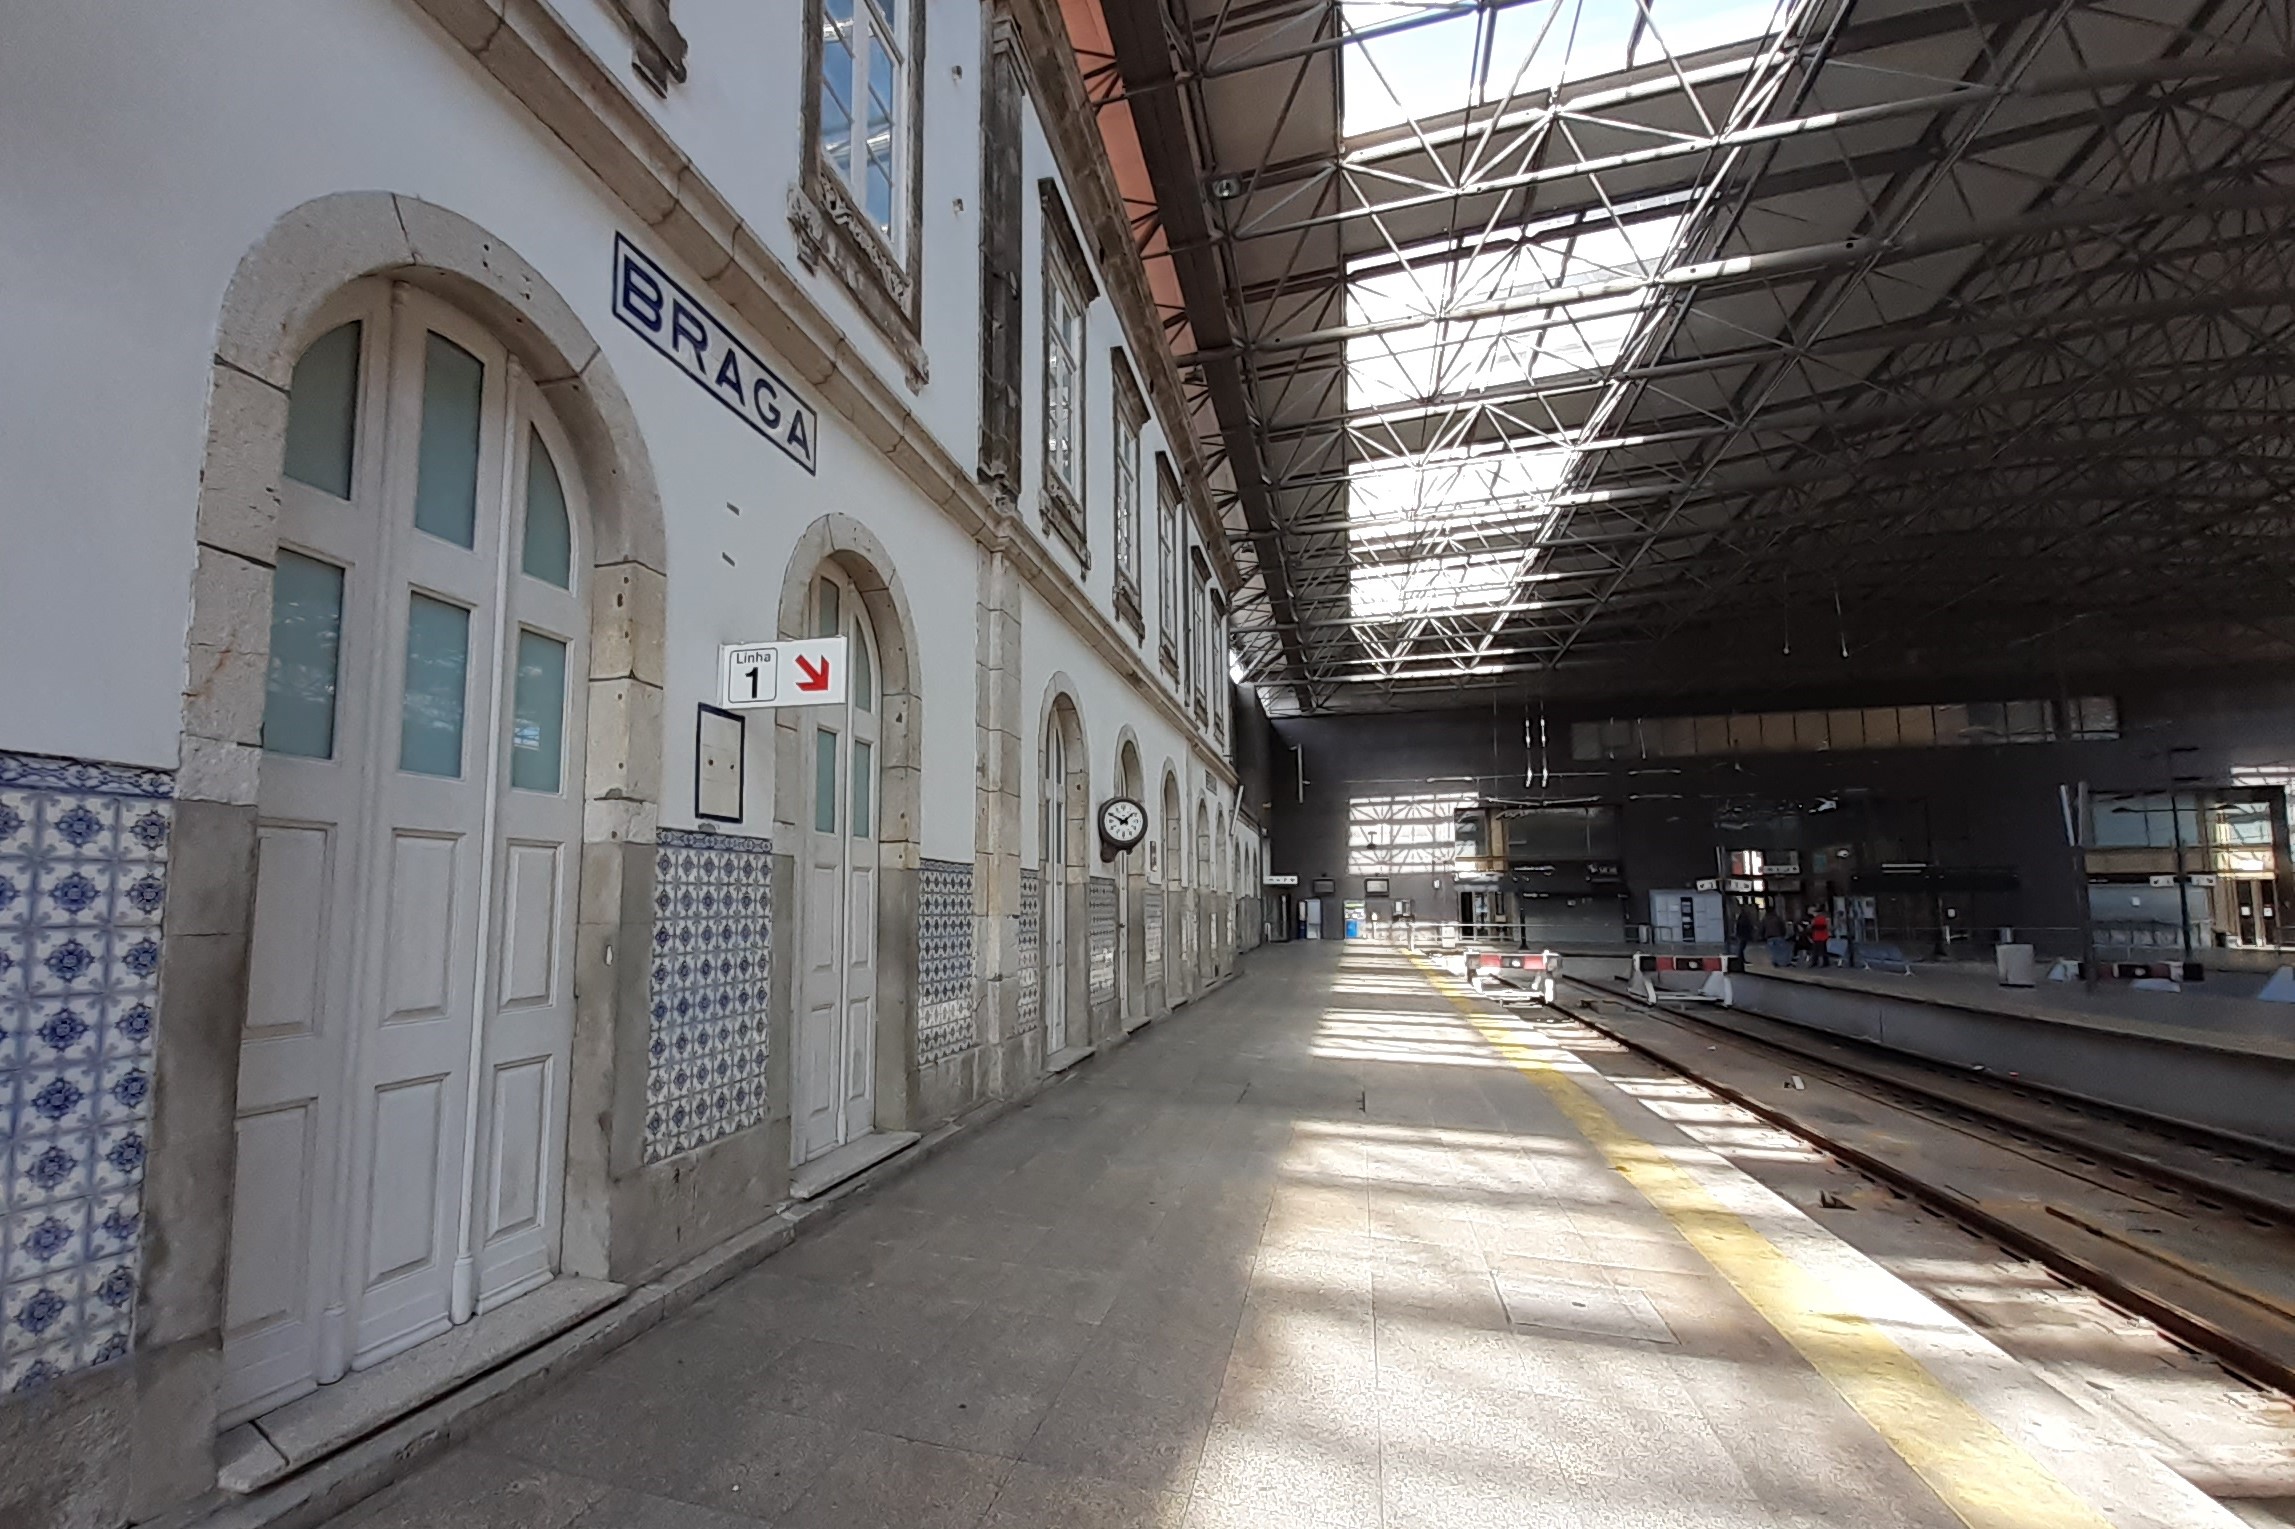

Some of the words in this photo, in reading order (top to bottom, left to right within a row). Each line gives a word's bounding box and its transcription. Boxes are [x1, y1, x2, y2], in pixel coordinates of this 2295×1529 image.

[622, 254, 811, 461] BRAGA
[736, 651, 772, 664] Linha
[745, 667, 759, 699] 1
